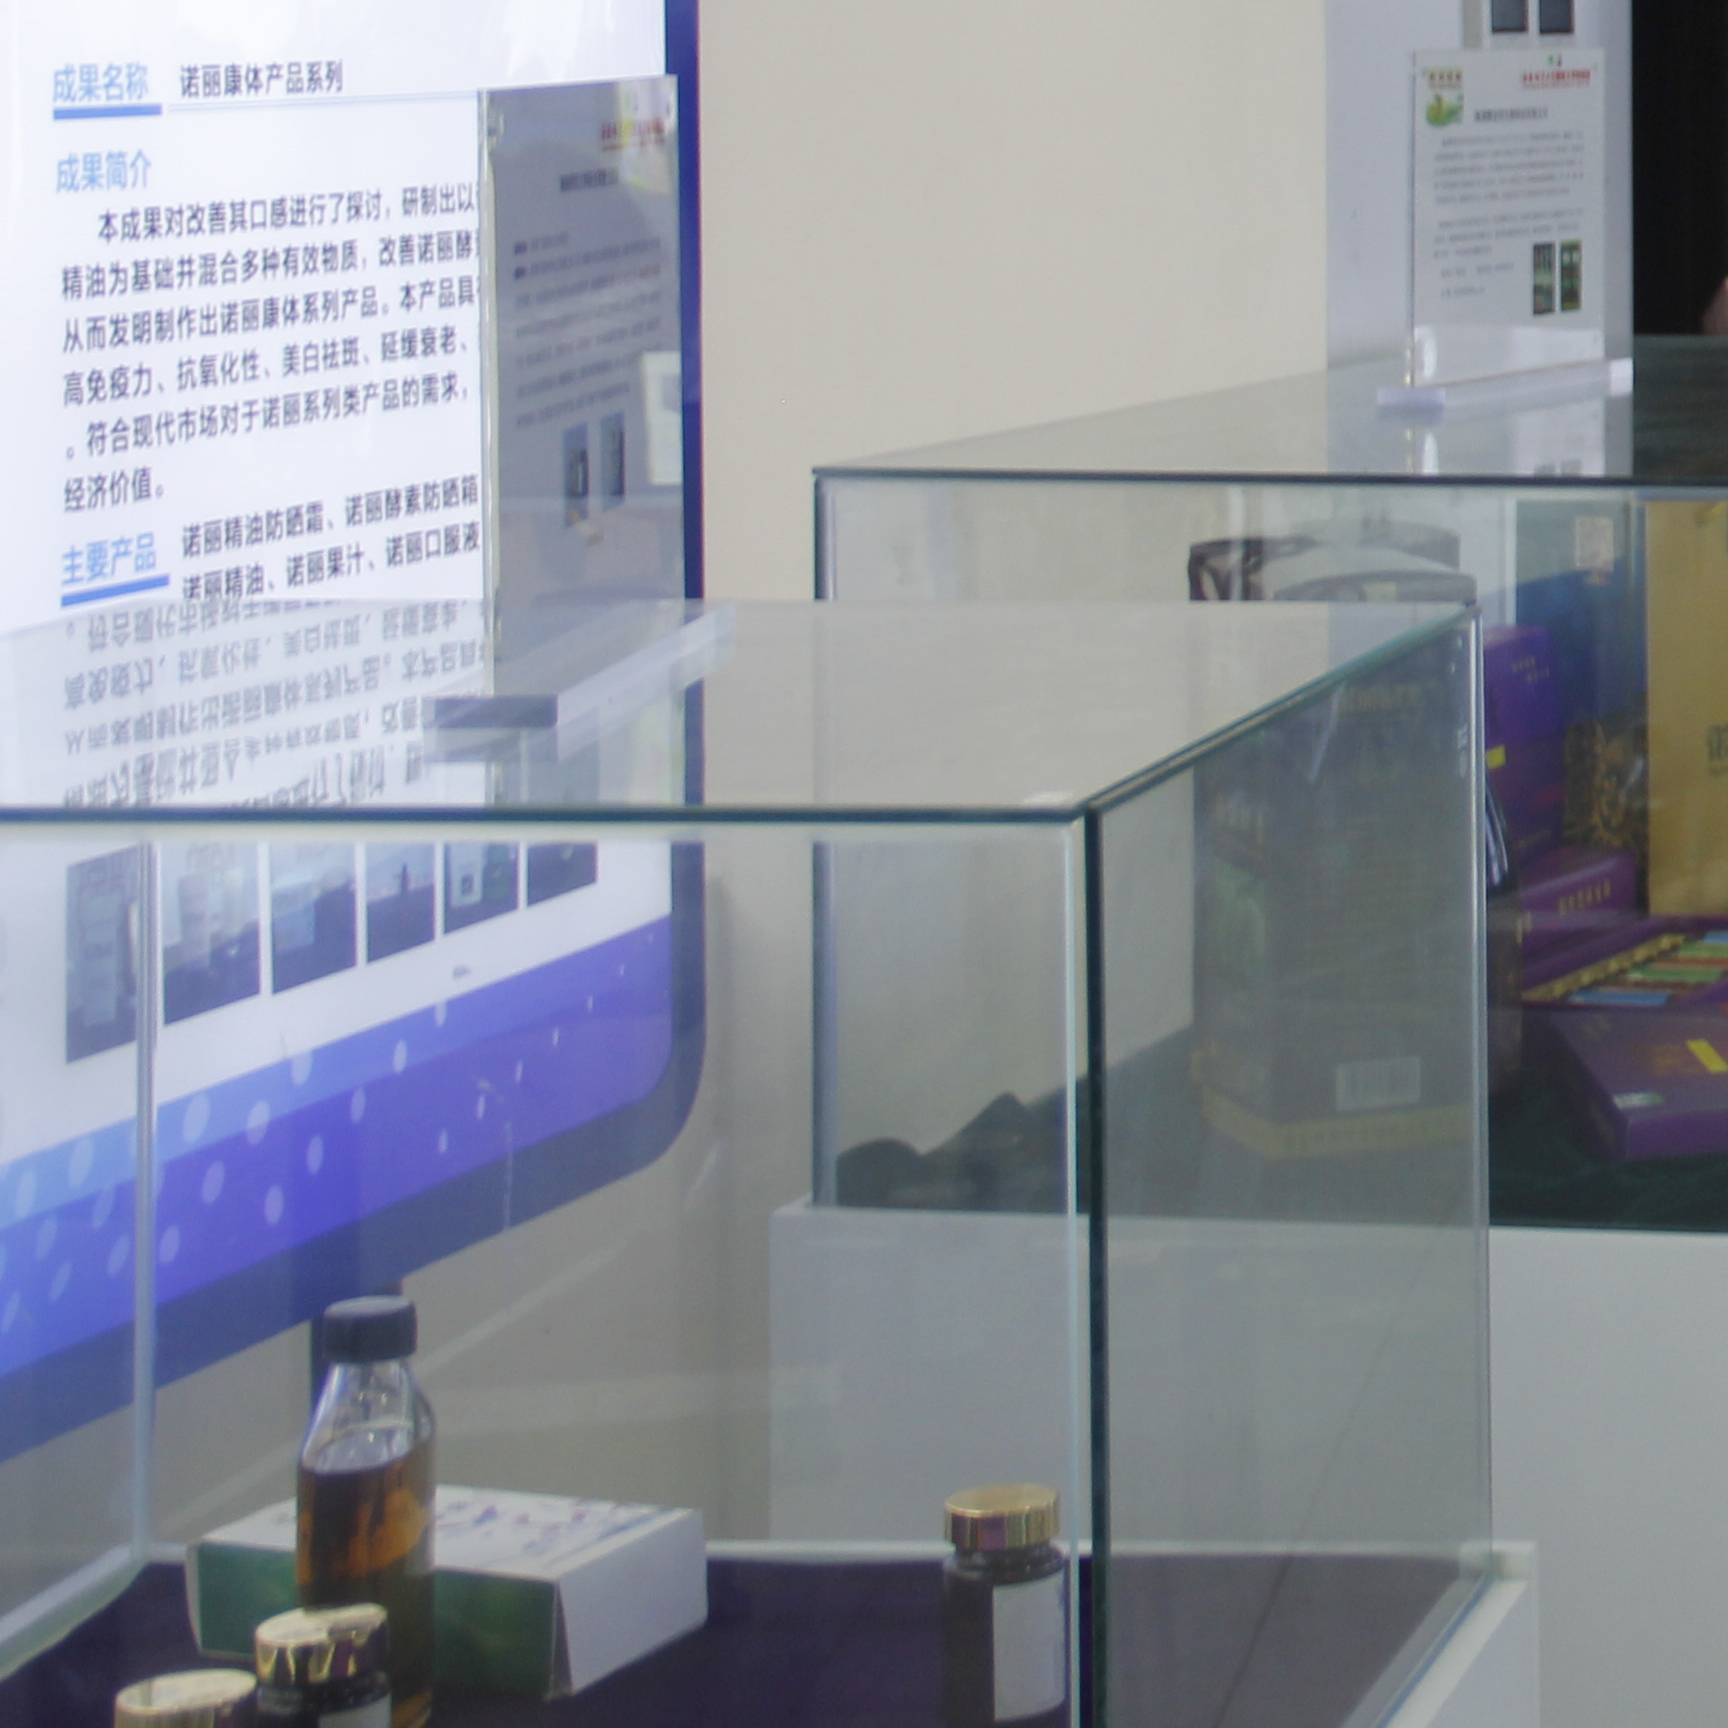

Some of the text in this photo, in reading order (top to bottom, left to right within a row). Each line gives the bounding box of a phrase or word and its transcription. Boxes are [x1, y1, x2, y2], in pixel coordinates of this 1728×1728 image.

[52, 61, 149, 104] 成果名称
[180, 59, 344, 100] 诺丽康体产品系列
[56, 148, 152, 193] 成果简介
[98, 182, 480, 244] 本成果对改善其口感进行了探讨，研制出以
[61, 228, 480, 300] 精油为基础并混合多种有效物质，改善诺丽酵
[62, 275, 480, 354] 从而发明制作出诺丽康体系列产品。本产品具
[63, 324, 468, 408] 高免疫力、抗氧化性、美白祛斑、延缓衰老、
[64, 466, 165, 513] 经济价值。
[60, 531, 157, 586] 主要产品
